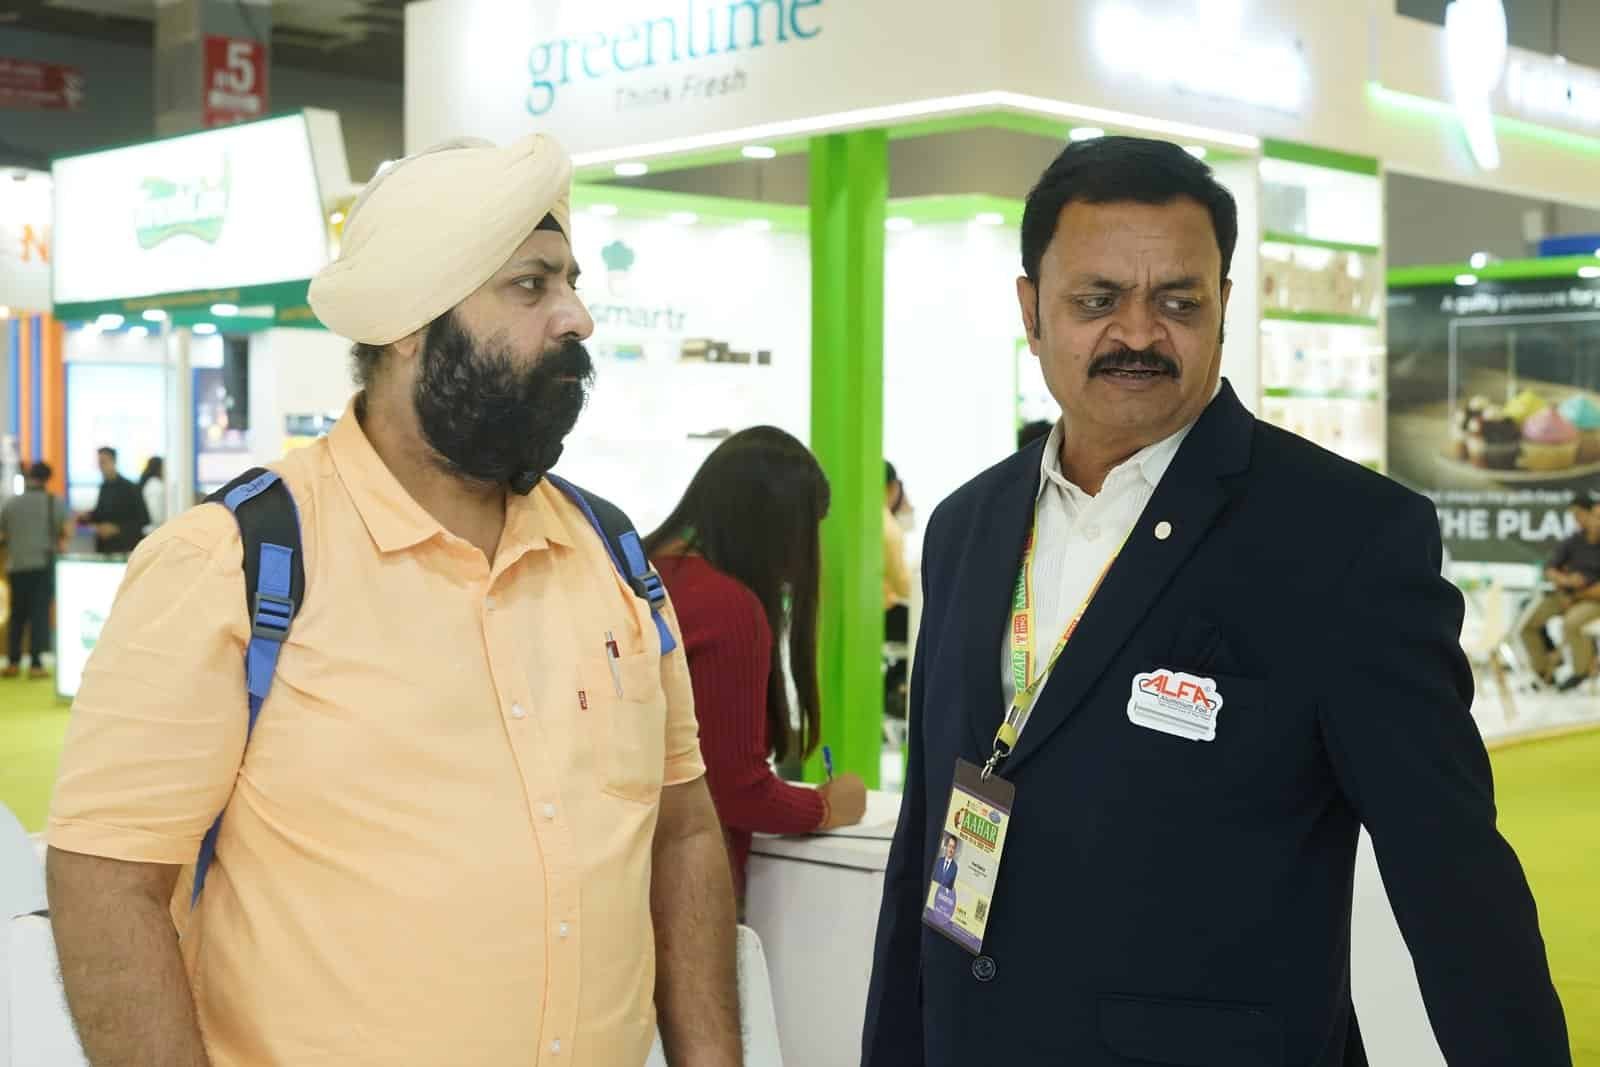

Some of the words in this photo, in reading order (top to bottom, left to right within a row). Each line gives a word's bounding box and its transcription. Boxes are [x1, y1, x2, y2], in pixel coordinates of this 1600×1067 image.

[525, 0, 822, 116] greenlime
[680, 66, 748, 104] Fresh
[1142, 674, 1212, 708] ALFA
[963, 813, 999, 845] AAHAR
